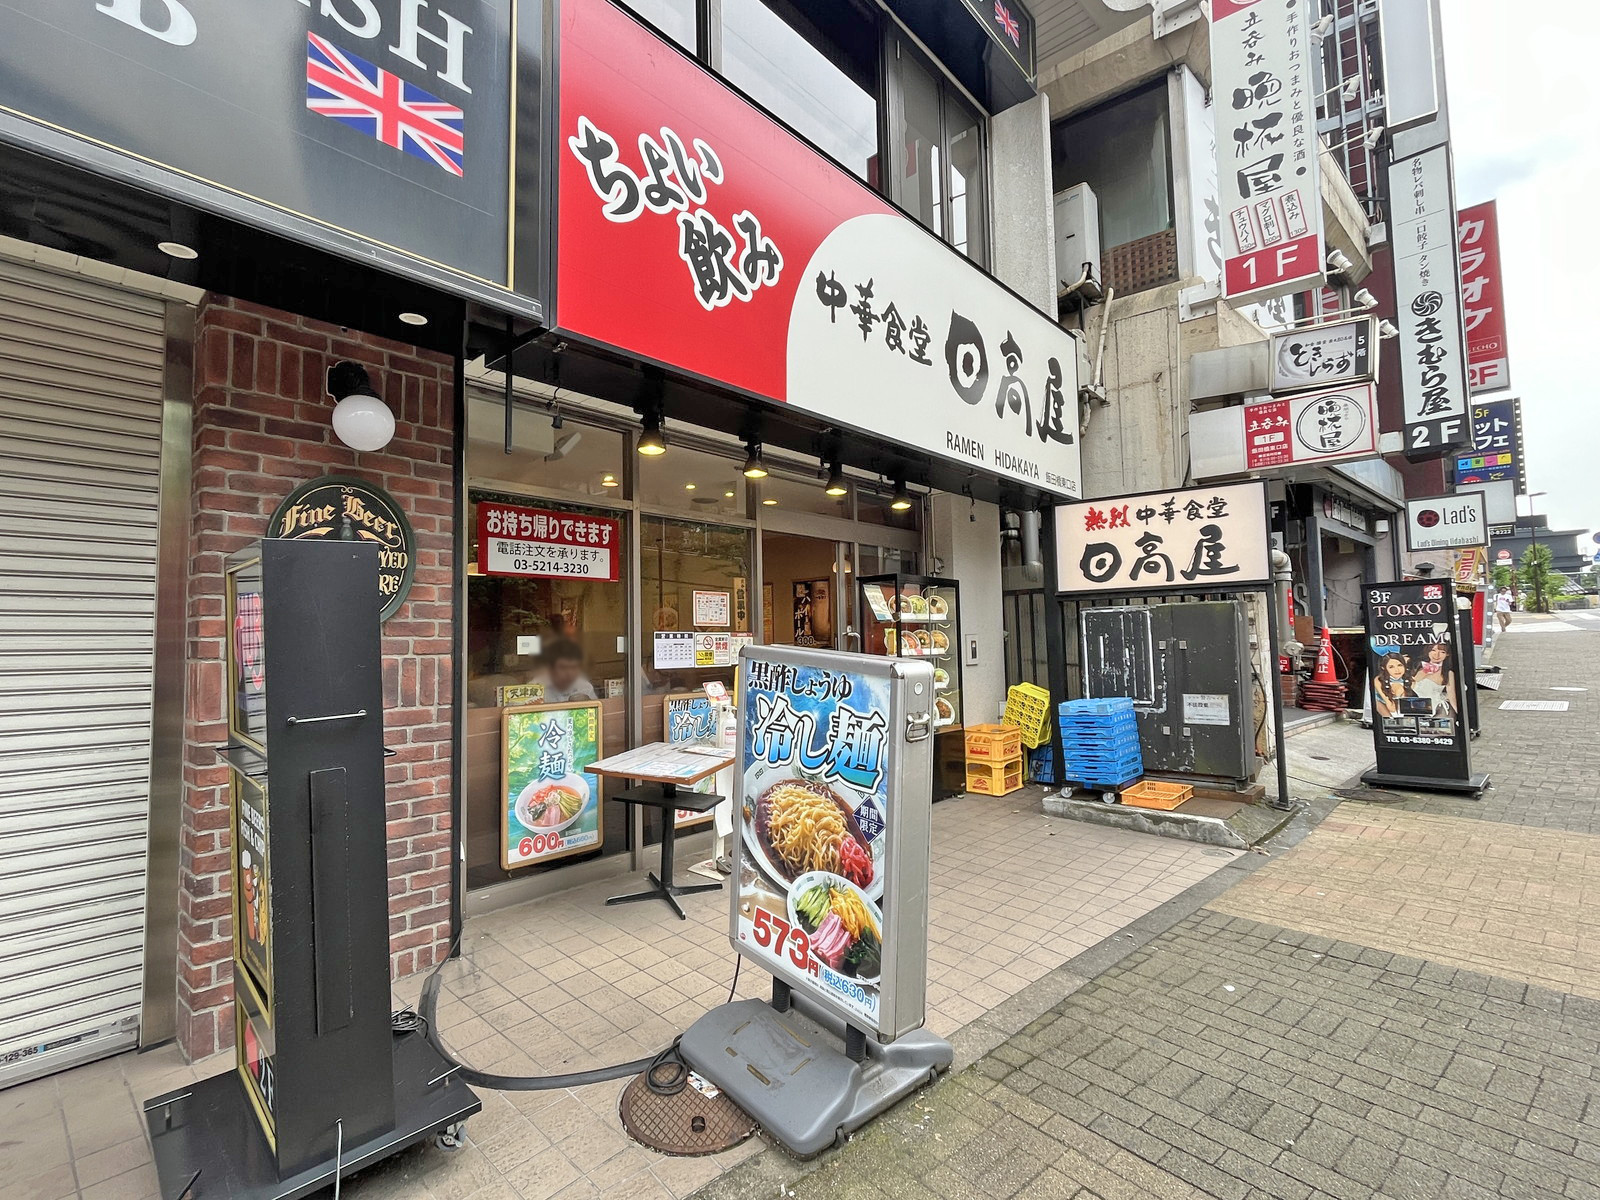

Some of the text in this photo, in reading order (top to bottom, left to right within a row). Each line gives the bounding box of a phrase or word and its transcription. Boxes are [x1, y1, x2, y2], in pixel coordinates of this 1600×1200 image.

[1286, 12, 1306, 162] 手作りおつまみと優良な酒
[568, 116, 724, 223] ちょい
[1412, 158, 1425, 216] 名物レバ刺し串
[1260, 202, 1275, 236] マグロ刺し
[1285, 194, 1299, 220] 煮込み
[1235, 211, 1250, 243] チュウハイ
[1415, 219, 1428, 251] 一口餃子
[679, 210, 784, 310] 飲み
[1419, 254, 1431, 287] タン焼き
[1459, 219, 1493, 332] カラオケ
[815, 269, 933, 368] 中華食堂
[944, 309, 1074, 445] 日高屋
[1415, 317, 1452, 417] きむら屋
[1474, 408, 1489, 419] 5F
[946, 430, 1040, 480] RAMEN HIDAKAYA
[279, 504, 336, 538] Fine
[486, 509, 613, 546] お持ち帰りできます
[1083, 496, 1230, 532] 熱烈 中華食堂
[1442, 505, 1476, 525] Lad's
[496, 541, 604, 563] 電話注文を承ります。
[1079, 524, 1241, 583] 日高屋
[1417, 539, 1431, 548] Lad's
[513, 559, 589, 575] 03-5214-3230
[1370, 590, 1392, 604] 3F
[1372, 602, 1441, 618] TOKYO
[1374, 632, 1446, 646] DREAM
[1384, 620, 1433, 630] ON THE
[1318, 638, 1330, 674] 立入禁止
[748, 660, 853, 702] 黒酢しょうゆ
[538, 718, 567, 783] 冷麺
[753, 694, 886, 790] 冷し麺
[1386, 735, 1399, 743] TEL
[859, 805, 879, 821] 期間
[859, 819, 878, 836] 限定
[518, 831, 565, 857] 600円
[753, 906, 819, 978] 573円
